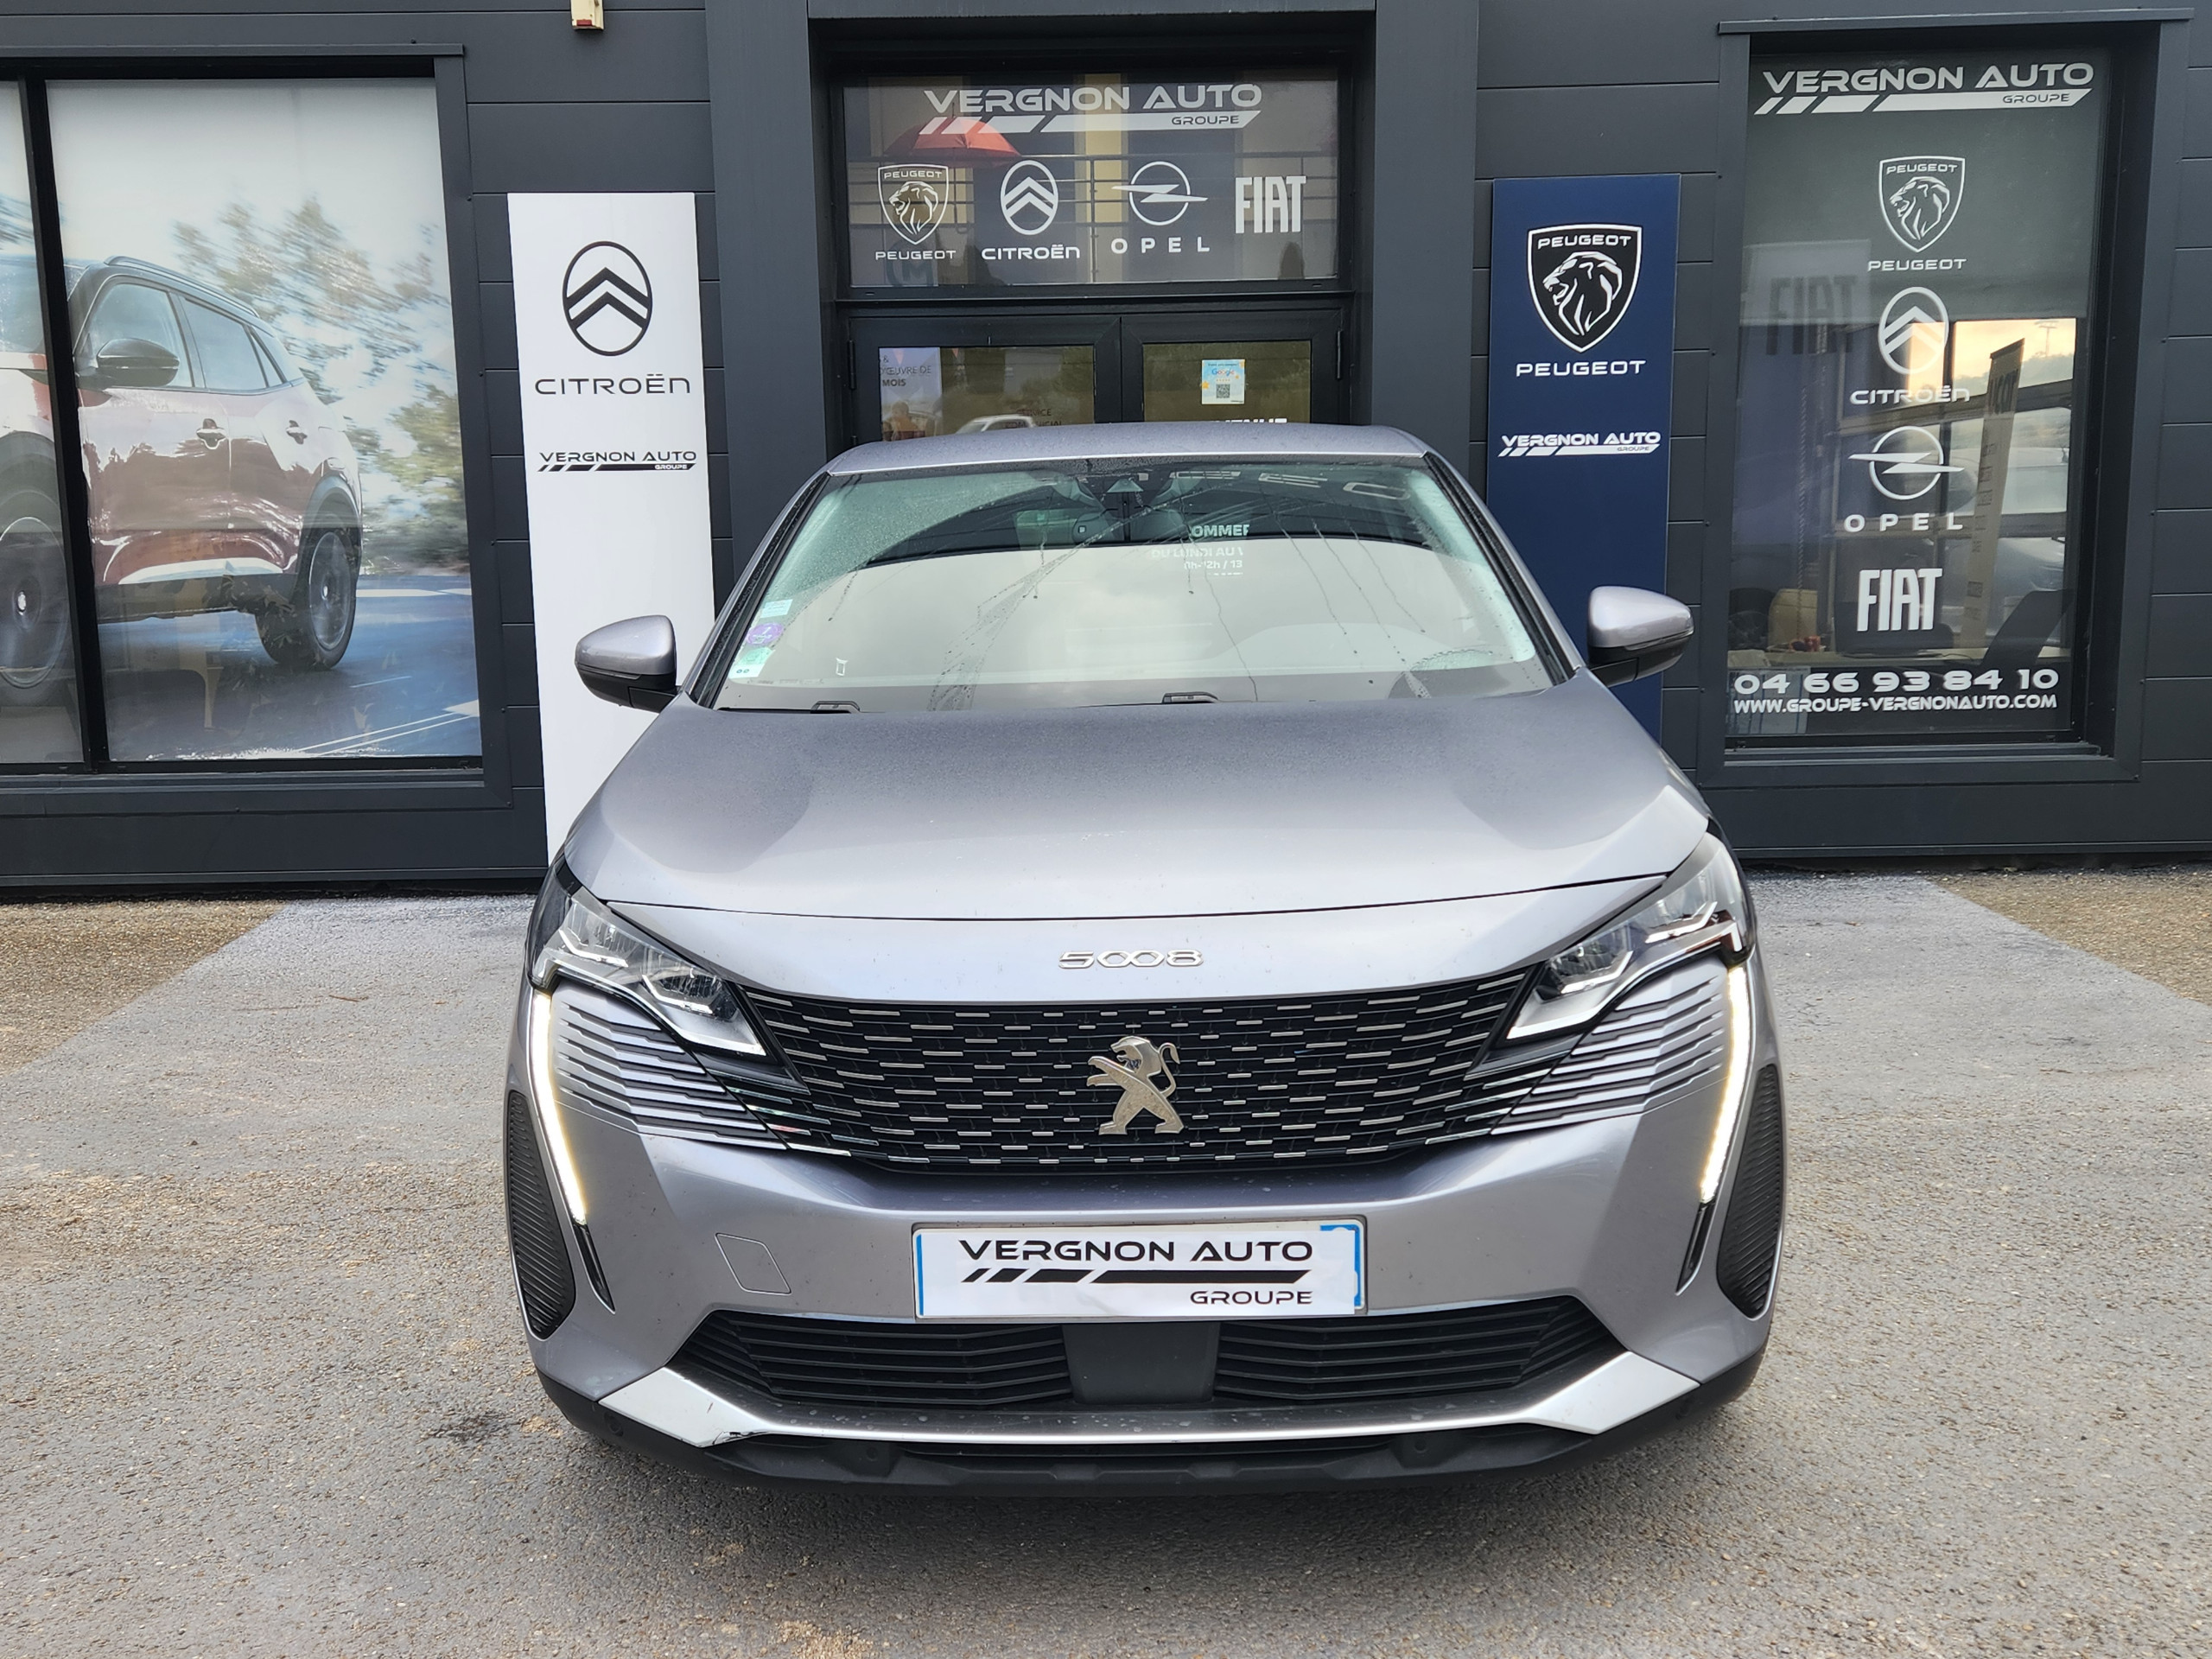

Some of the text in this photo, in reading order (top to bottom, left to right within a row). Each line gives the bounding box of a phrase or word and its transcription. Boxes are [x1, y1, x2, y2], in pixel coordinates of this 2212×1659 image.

[1763, 62, 2094, 95] VERGNON AUTO
[924, 82, 1263, 114] VERGNON AUTO
[2002, 92, 2071, 105] GROUPE
[1171, 114, 1241, 126] GROUPE
[883, 169, 943, 180] PEUGEOT
[1885, 162, 1960, 175] PEUGEOT
[1235, 175, 1307, 234] FIAT
[1110, 237, 1211, 254] OPEL
[1537, 233, 1633, 250] PEUGEOT
[874, 249, 957, 261] PEUGEOT
[981, 243, 1081, 259] CITROËN
[1867, 257, 1967, 272] PEUGEOT
[1516, 359, 1647, 378] PEUGEOT
[535, 373, 690, 395] CITROËN
[881, 378, 907, 388] MOIS
[1849, 385, 1971, 405] CITROËN
[1503, 431, 1662, 448] VERGNON AUTO
[539, 451, 696, 462] VERGNON AUTO
[1844, 512, 1964, 533] OPEL
[1856, 568, 1943, 632] FIAT
[1733, 668, 2060, 695] 04 66 93 84 10
[1733, 694, 2058, 714] WWW.GROUPE-VERGNONAUTO.COM
[1058, 950, 1204, 969] 5008
[959, 1239, 1313, 1262] VERGNON AUTO
[1190, 1290, 1313, 1306] GROUPE
